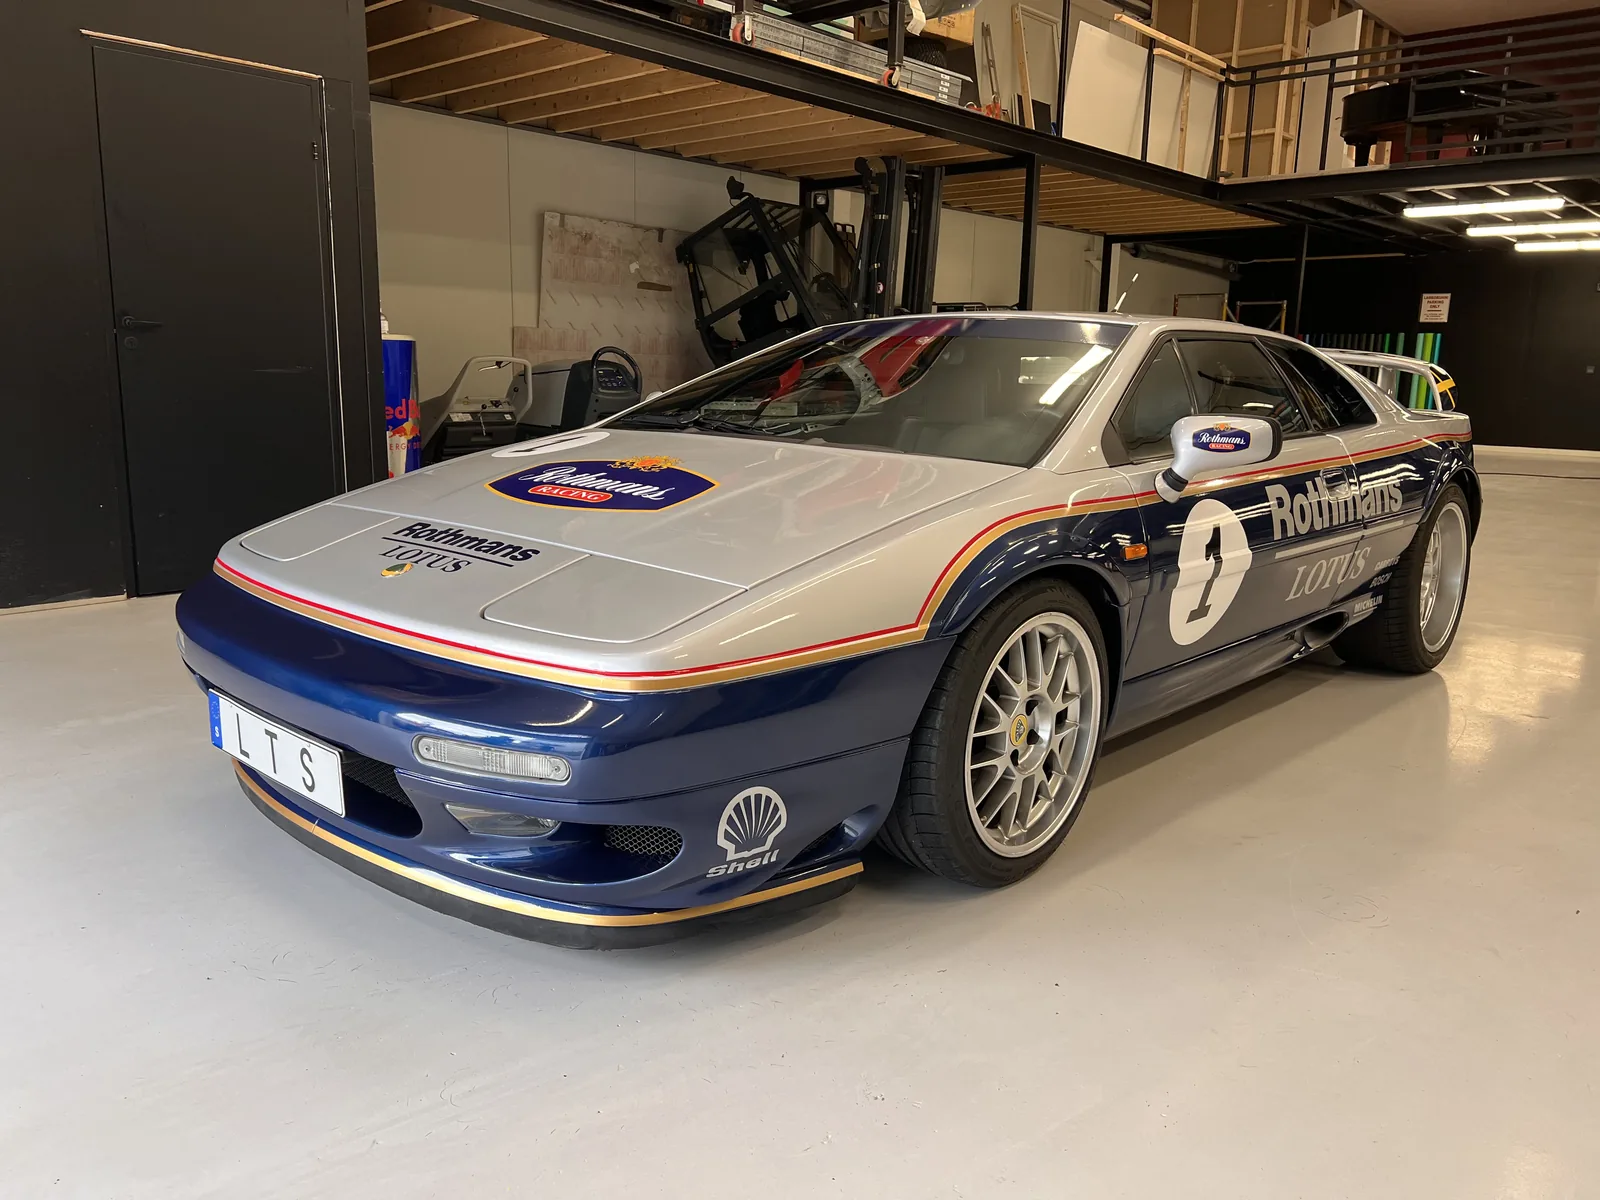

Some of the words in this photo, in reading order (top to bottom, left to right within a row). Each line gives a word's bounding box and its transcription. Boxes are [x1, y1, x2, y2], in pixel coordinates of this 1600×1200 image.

[385, 398, 407, 419] ed
[1198, 432, 1247, 445] Rothmans
[518, 466, 676, 501] Rothmans
[537, 485, 604, 501] RACING
[1265, 476, 1403, 540] Rothmans
[392, 522, 541, 561] Rothmans
[379, 545, 472, 573] LOTUS
[1186, 523, 1223, 624] 1
[1285, 546, 1372, 601] LOTUS
[1353, 594, 1383, 613] MICHELIN
[706, 848, 780, 878] Shell
